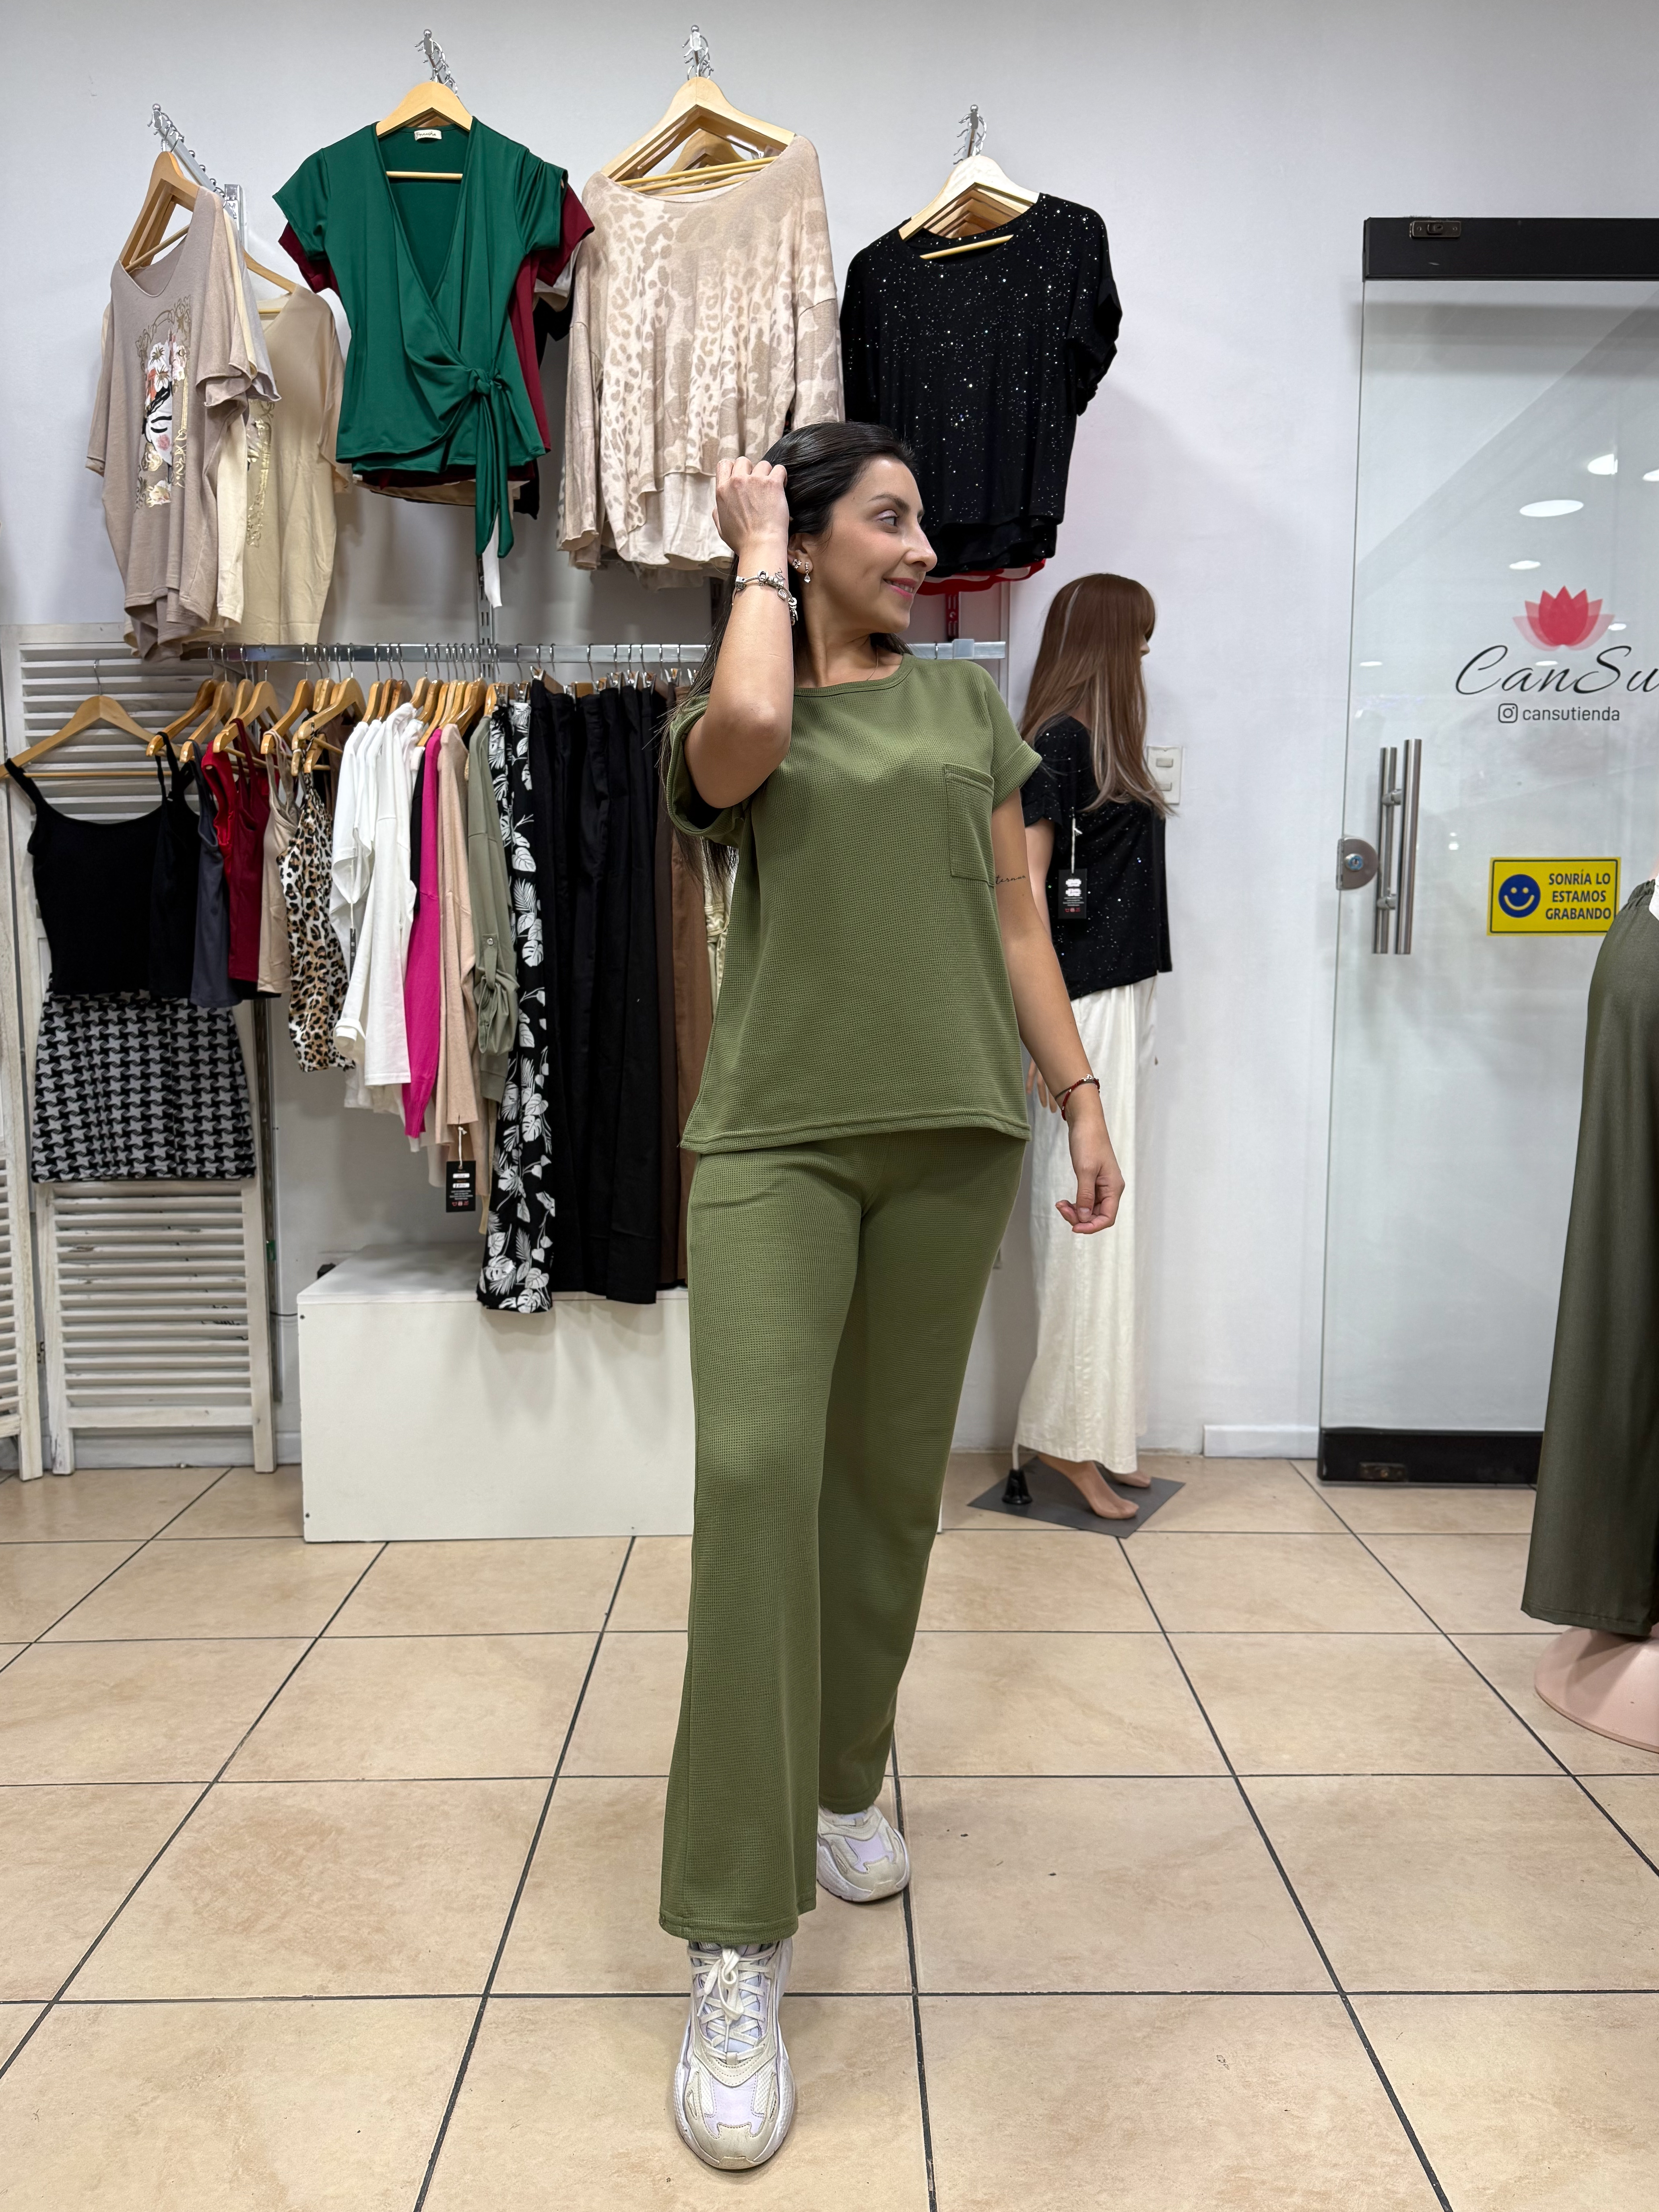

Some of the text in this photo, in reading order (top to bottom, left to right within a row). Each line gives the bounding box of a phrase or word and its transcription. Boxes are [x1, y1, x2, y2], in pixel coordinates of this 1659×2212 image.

[1523, 706, 1620, 721] cansutienda
[1549, 869, 1611, 885] SONRÍA LO
[1552, 890, 1606, 902] ESTAMOS
[1546, 908, 1611, 920] GRABANDO
